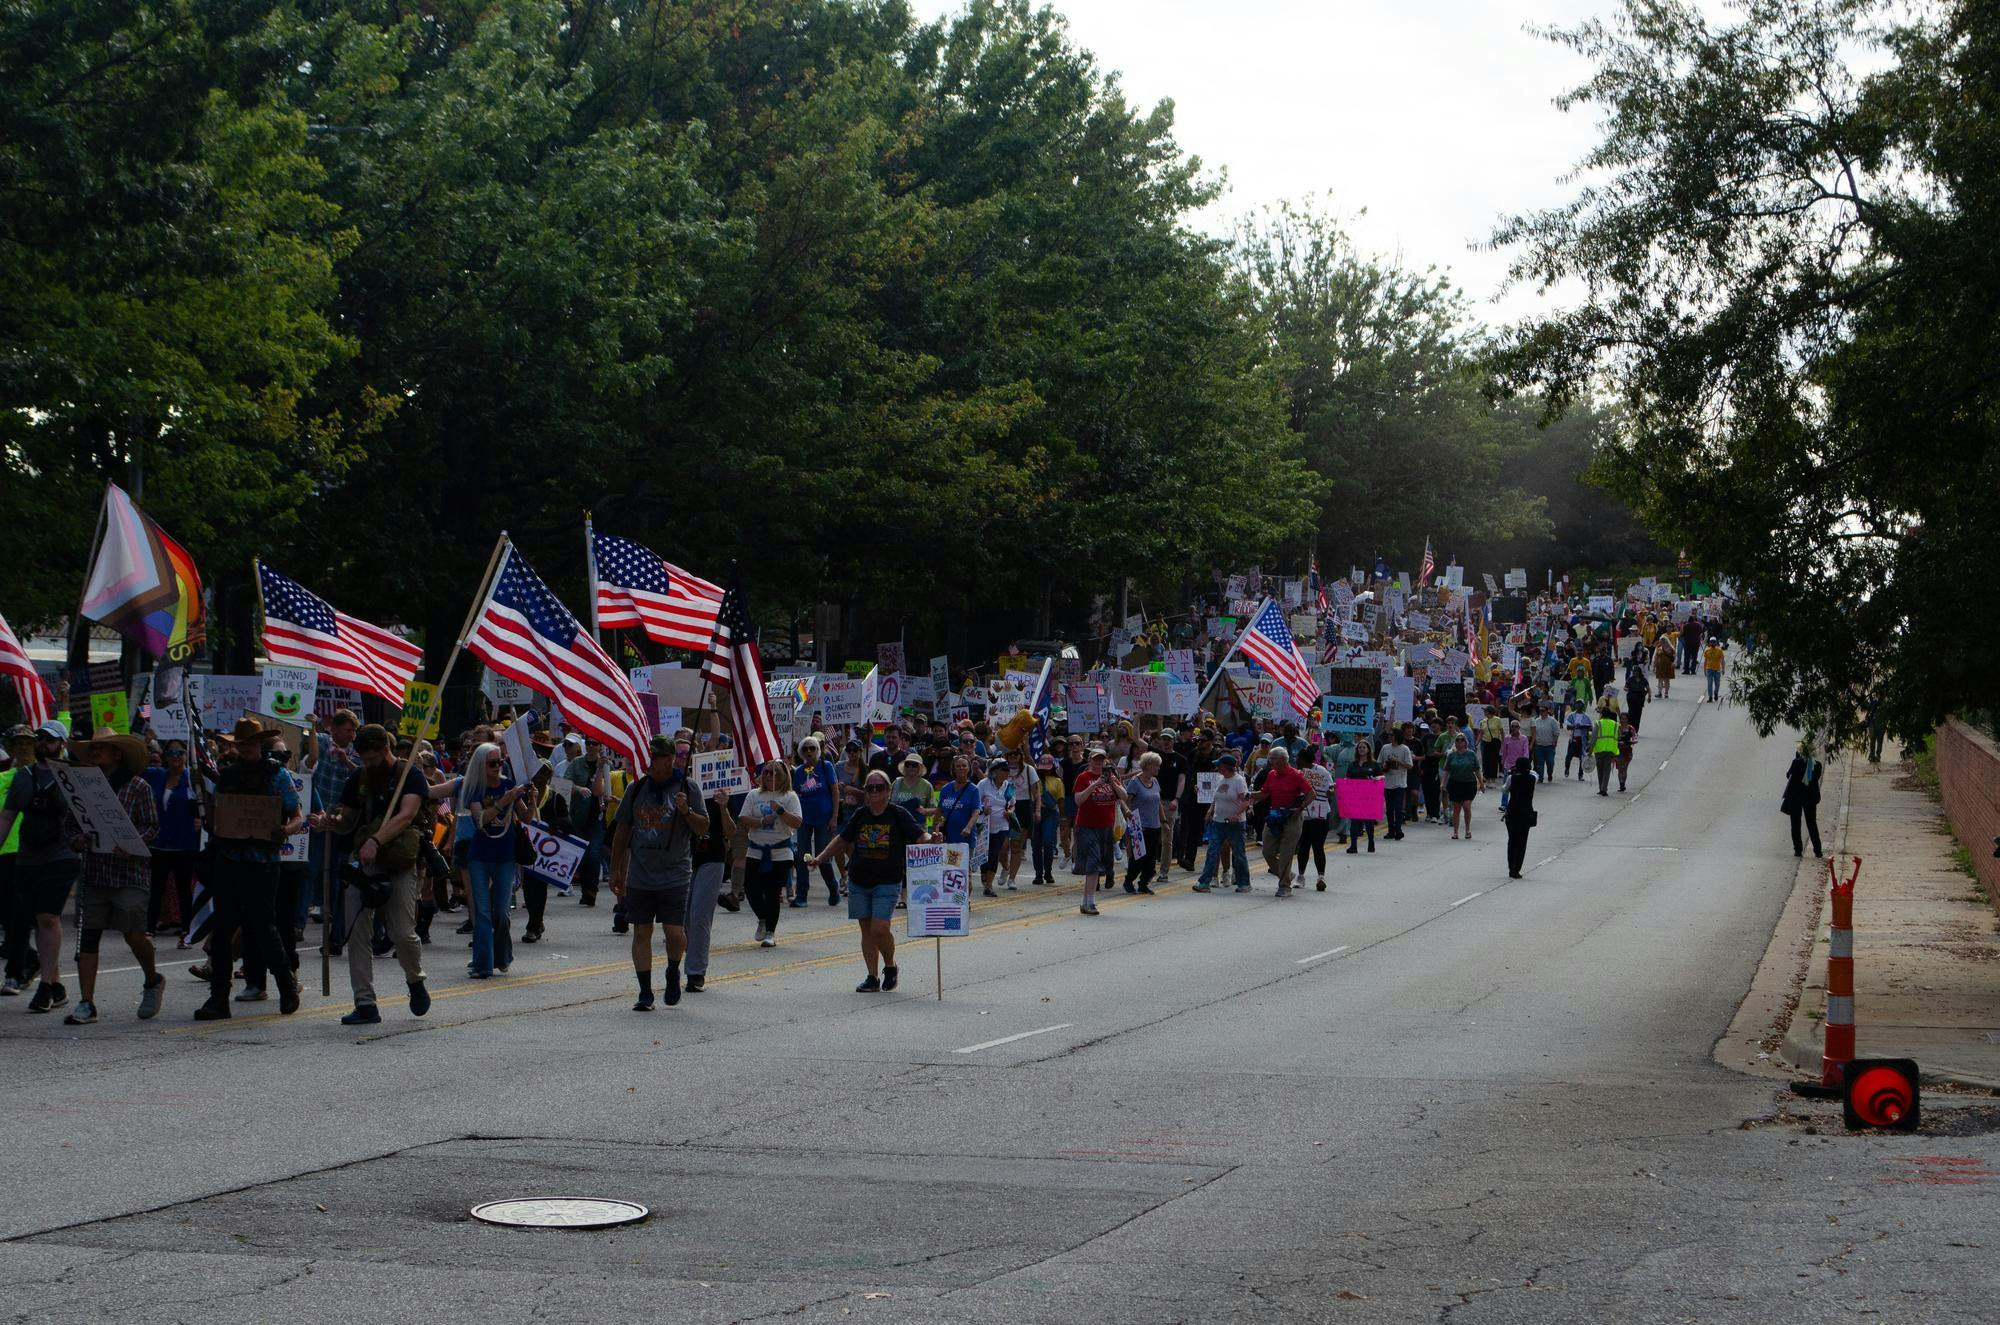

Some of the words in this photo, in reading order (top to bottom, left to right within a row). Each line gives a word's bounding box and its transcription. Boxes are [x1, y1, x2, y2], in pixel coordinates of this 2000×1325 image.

[270, 669, 273, 678] I
[276, 669, 308, 681] STAND
[1120, 674, 1137, 685] ARE
[1142, 676, 1158, 687] WE
[264, 679, 282, 688] WITH
[283, 680, 296, 688] THE
[297, 681, 314, 691] FROG
[1257, 681, 1273, 694] NO
[410, 687, 429, 704] NO
[496, 689, 518, 699] LIES
[831, 695, 845, 703] LIES
[966, 688, 983, 699] SAVE
[1248, 692, 1275, 708] Kings
[222, 696, 258, 711] NOT
[1133, 699, 1153, 711] YET?
[1328, 700, 1369, 714] DEPORT
[401, 703, 439, 725] KINS
[832, 712, 851, 720] HATE
[1326, 713, 1367, 727] FASCISTS
[701, 762, 713, 773] NO
[716, 759, 735, 771] KIN
[718, 770, 726, 779] IN
[702, 776, 742, 791] AMERICA
[907, 846, 920, 859] NO
[920, 846, 944, 858] KINGS
[913, 856, 944, 867] AMERICA
